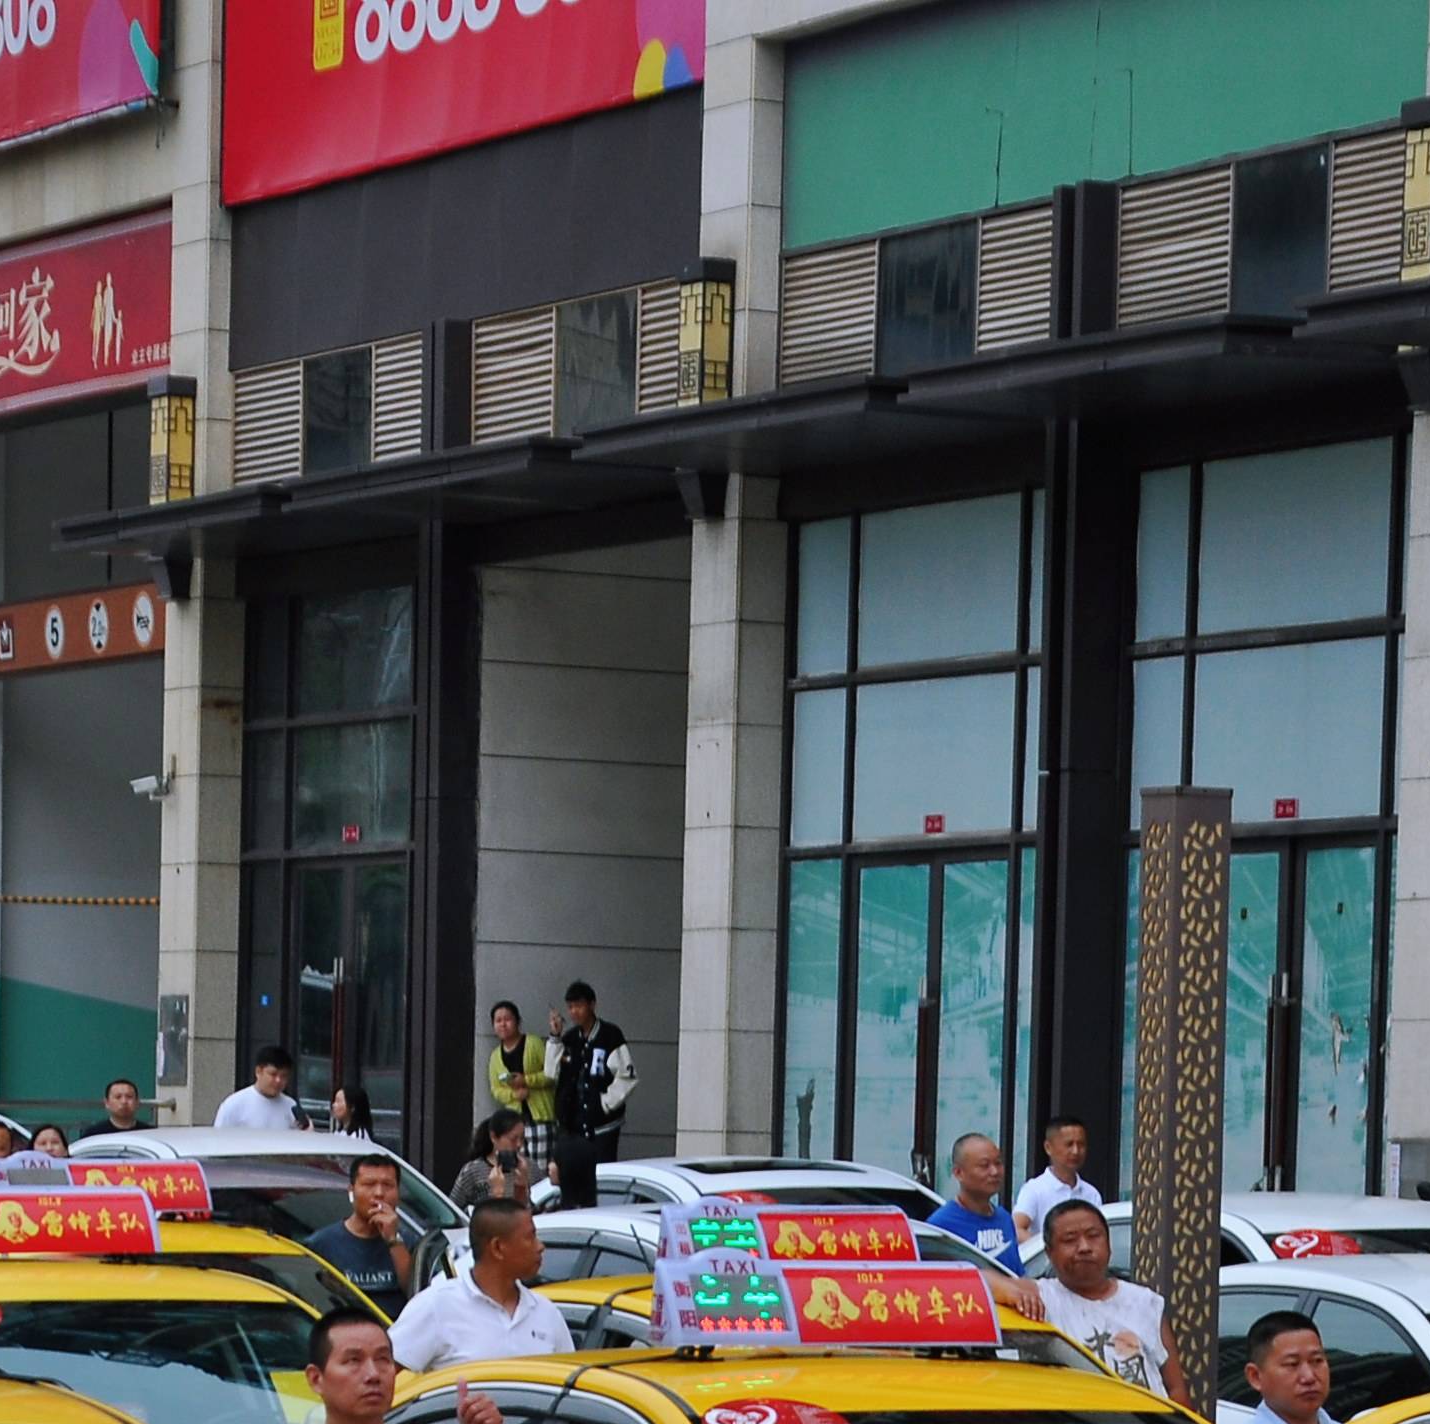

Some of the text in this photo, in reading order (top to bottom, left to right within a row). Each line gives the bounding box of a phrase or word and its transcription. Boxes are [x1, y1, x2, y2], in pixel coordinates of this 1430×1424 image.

[50, 617, 60, 647] 5
[702, 1205, 739, 1217] TAXI
[709, 1258, 757, 1275] TAXI
